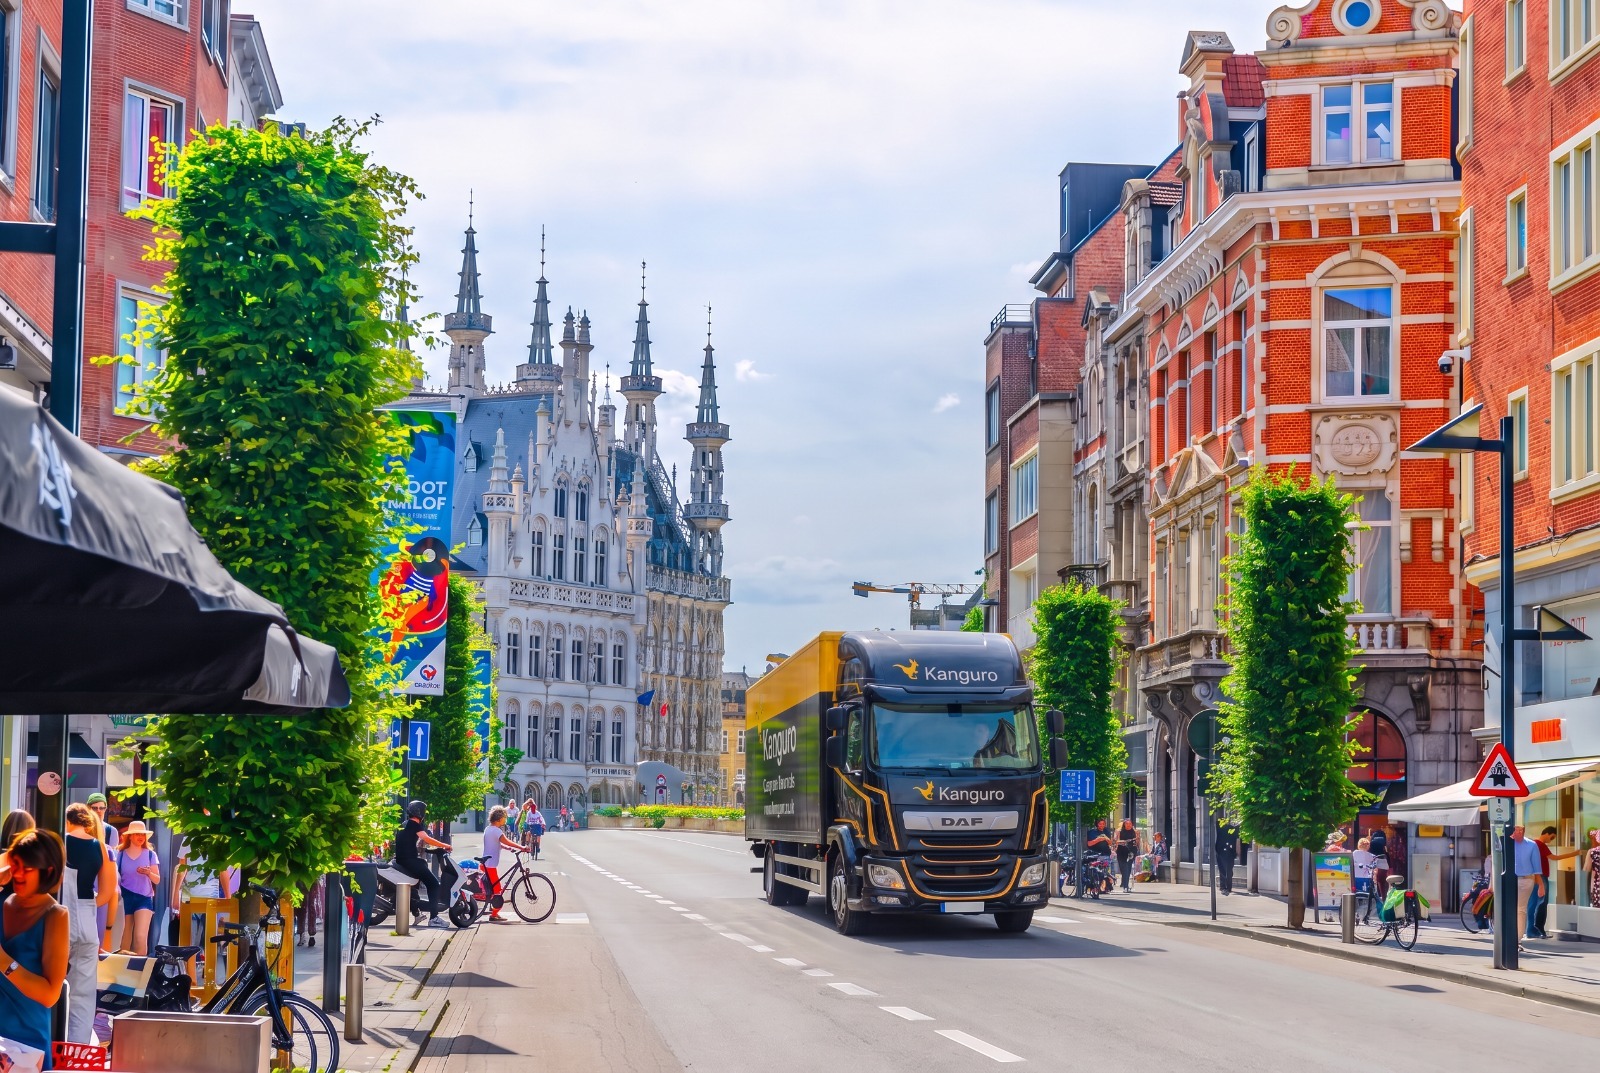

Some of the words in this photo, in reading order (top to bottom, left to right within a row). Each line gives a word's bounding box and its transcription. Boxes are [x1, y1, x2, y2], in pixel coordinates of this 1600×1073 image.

[924, 666, 998, 685] Kanguro
[762, 725, 797, 766] Kanguro
[939, 786, 1005, 804] Kanguro
[941, 817, 983, 826] DAF
